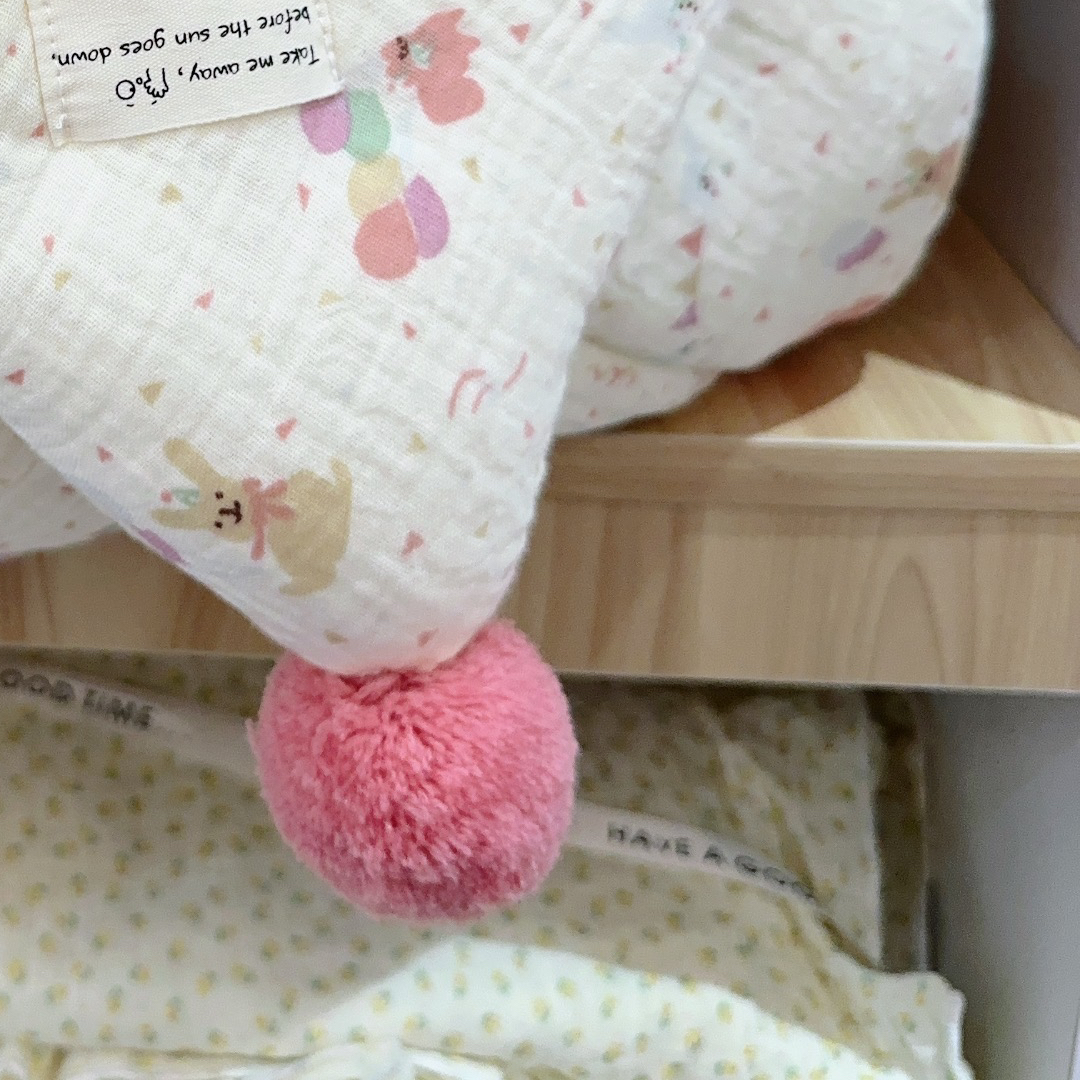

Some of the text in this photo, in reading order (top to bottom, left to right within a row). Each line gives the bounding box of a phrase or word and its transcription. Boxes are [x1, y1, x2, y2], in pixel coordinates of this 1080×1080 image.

[217, 19, 252, 39] the
[257, 6, 311, 35] before
[119, 27, 166, 57] goes
[174, 28, 210, 45] sun
[177, 45, 320, 82] Take me away,
